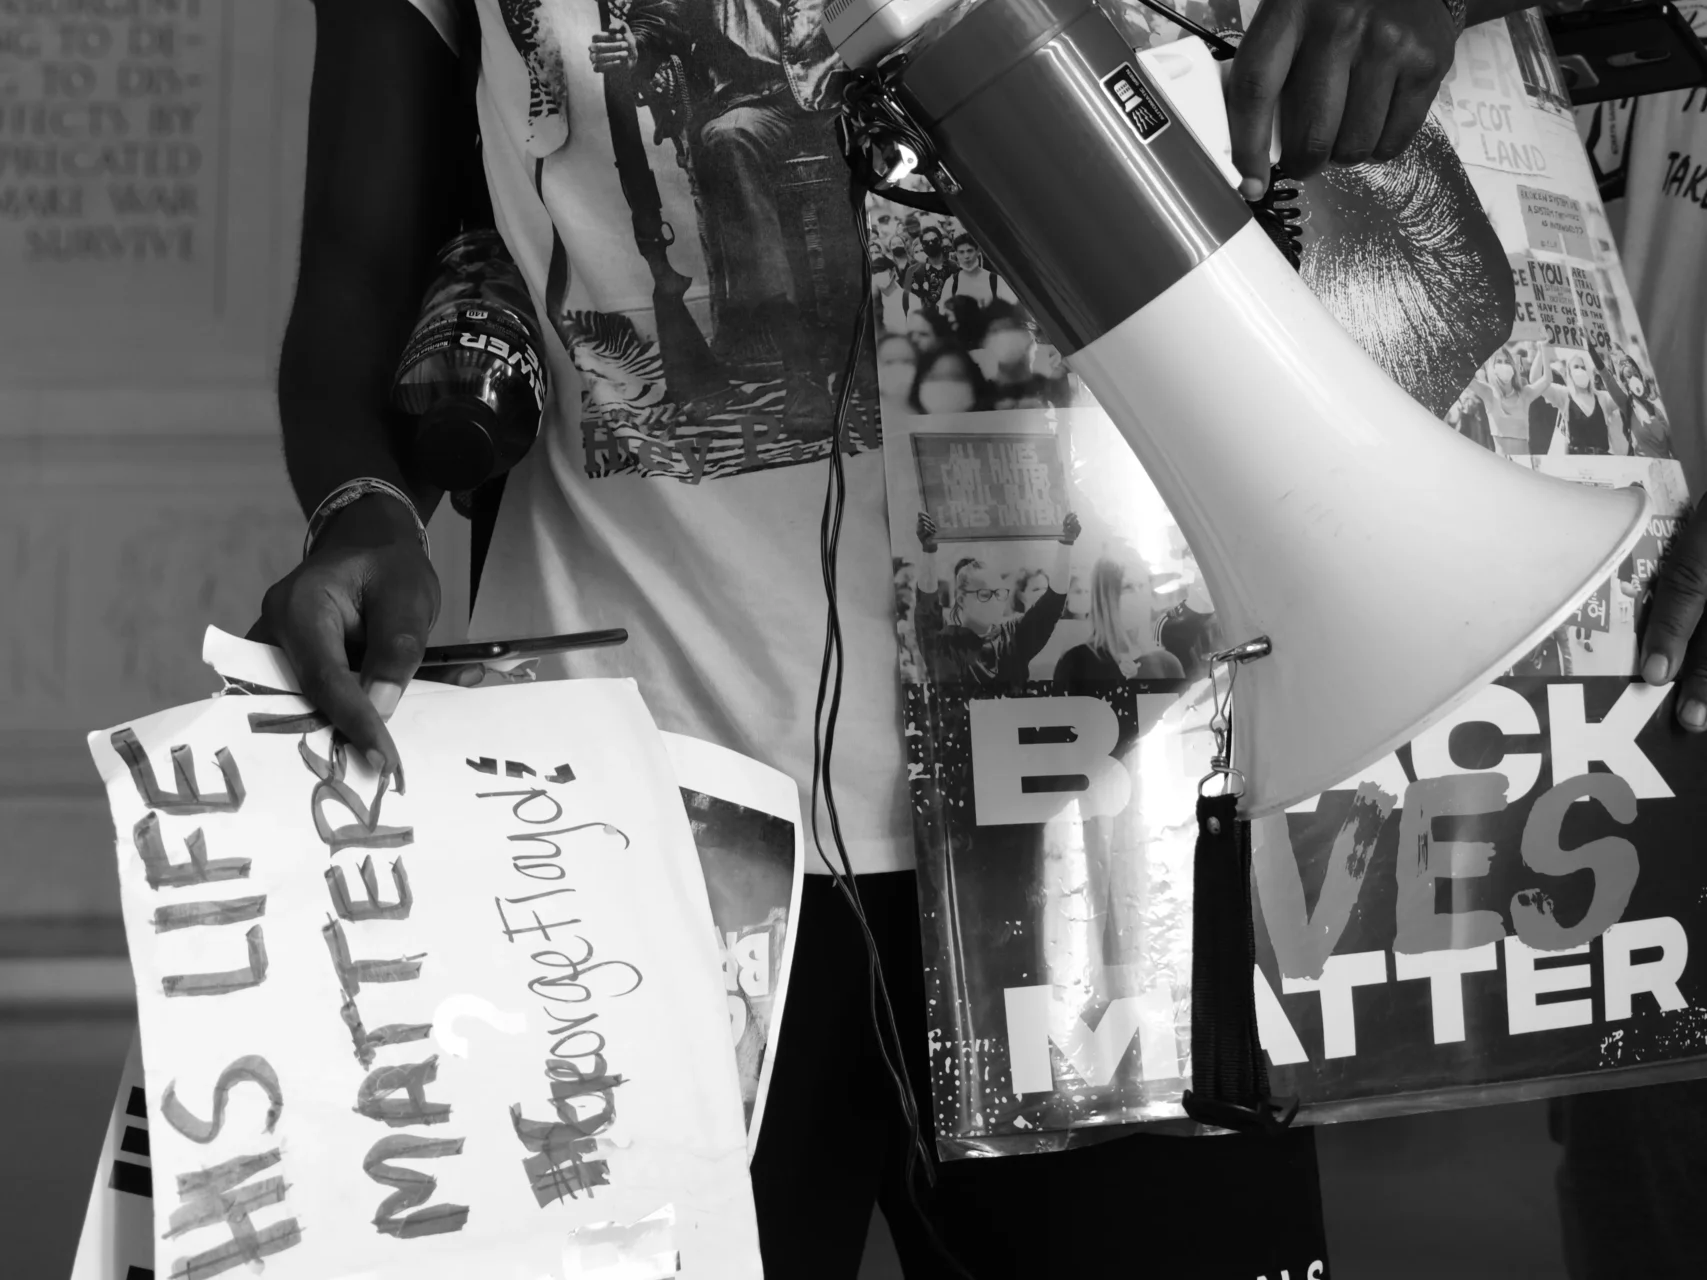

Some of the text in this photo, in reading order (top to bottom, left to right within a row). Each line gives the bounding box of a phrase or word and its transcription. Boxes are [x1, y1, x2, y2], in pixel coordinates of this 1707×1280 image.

[1456, 98, 1513, 134] SCOT
[1479, 133, 1548, 172] LAND
[1527, 260, 1537, 283] IF
[1537, 261, 1563, 286] YOU
[1576, 289, 1602, 310] YOU
[110, 726, 268, 998] LIFE
